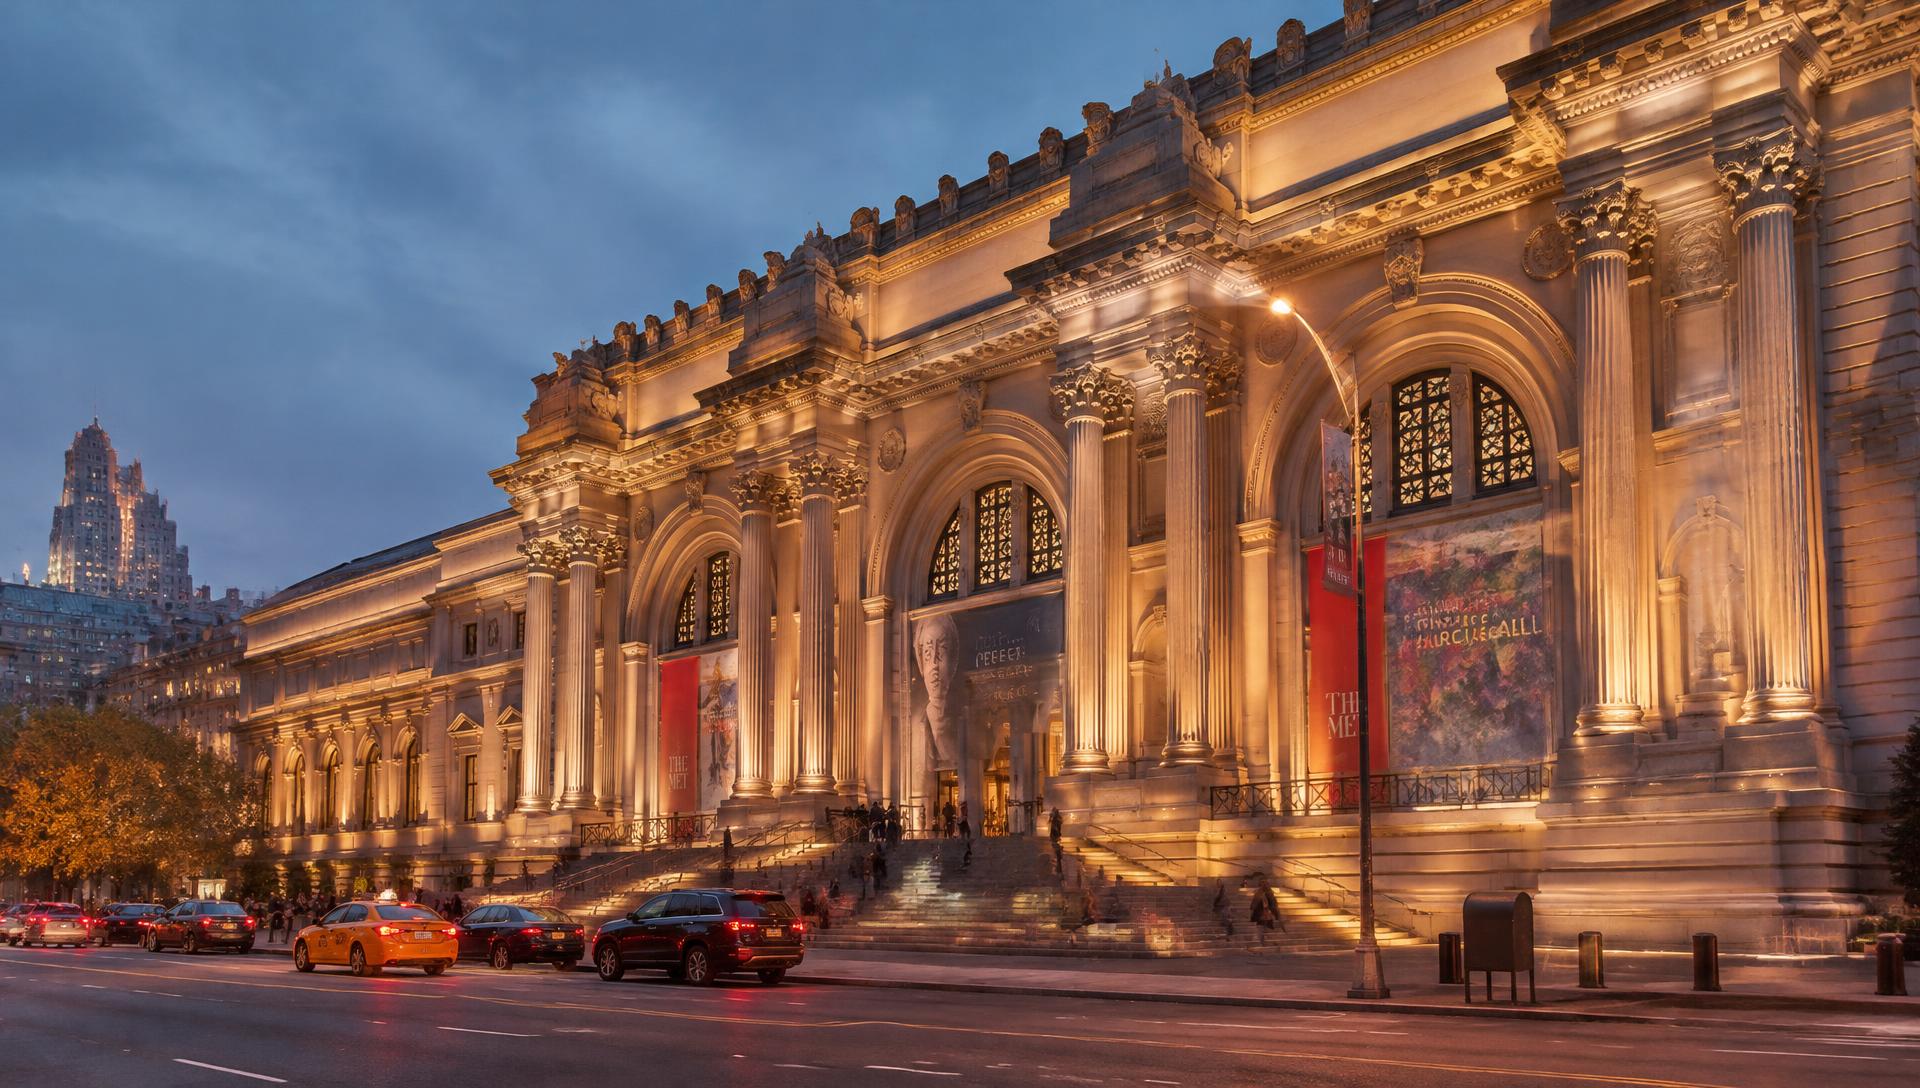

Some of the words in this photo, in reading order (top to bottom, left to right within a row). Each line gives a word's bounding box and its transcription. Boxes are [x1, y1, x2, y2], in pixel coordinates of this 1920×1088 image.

[1327, 714, 1359, 740] ME
[668, 755, 688, 773] THE
[668, 772, 688, 792] MET
